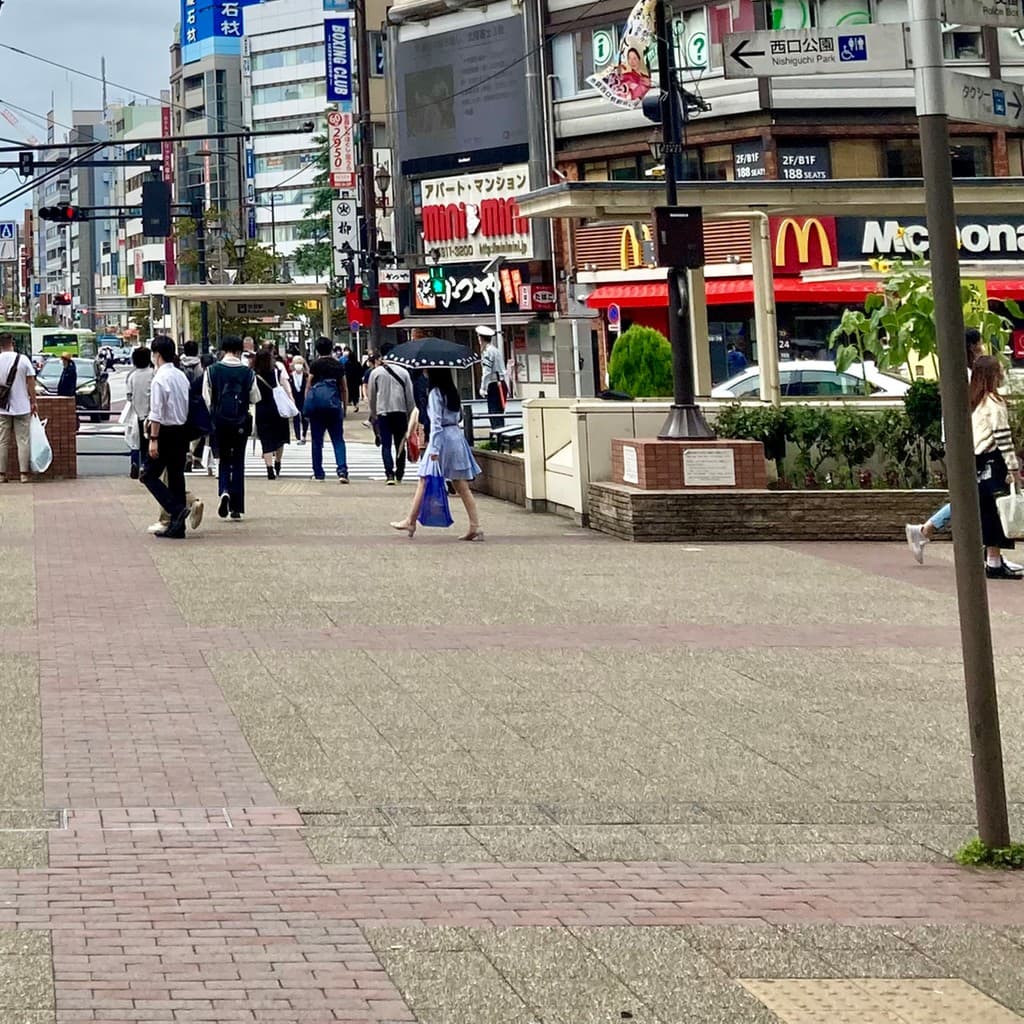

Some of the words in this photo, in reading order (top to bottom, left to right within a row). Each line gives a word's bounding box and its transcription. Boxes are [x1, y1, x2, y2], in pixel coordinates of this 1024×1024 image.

[332, 25, 347, 68] BOXING
[771, 40, 834, 55] 西口公園
[773, 56, 810, 68] Nishiguchi
[813, 55, 835, 66] Park
[335, 70, 348, 95] CLUB
[962, 86, 991, 99] タクシー
[332, 127, 342, 167] 2950
[736, 167, 751, 178] 188
[783, 169, 802, 179] 188
[803, 171, 826, 179] SEATS
[425, 175, 526, 199] アパート・マンション
[422, 201, 468, 242] mini
[862, 220, 1024, 254] Mcon
